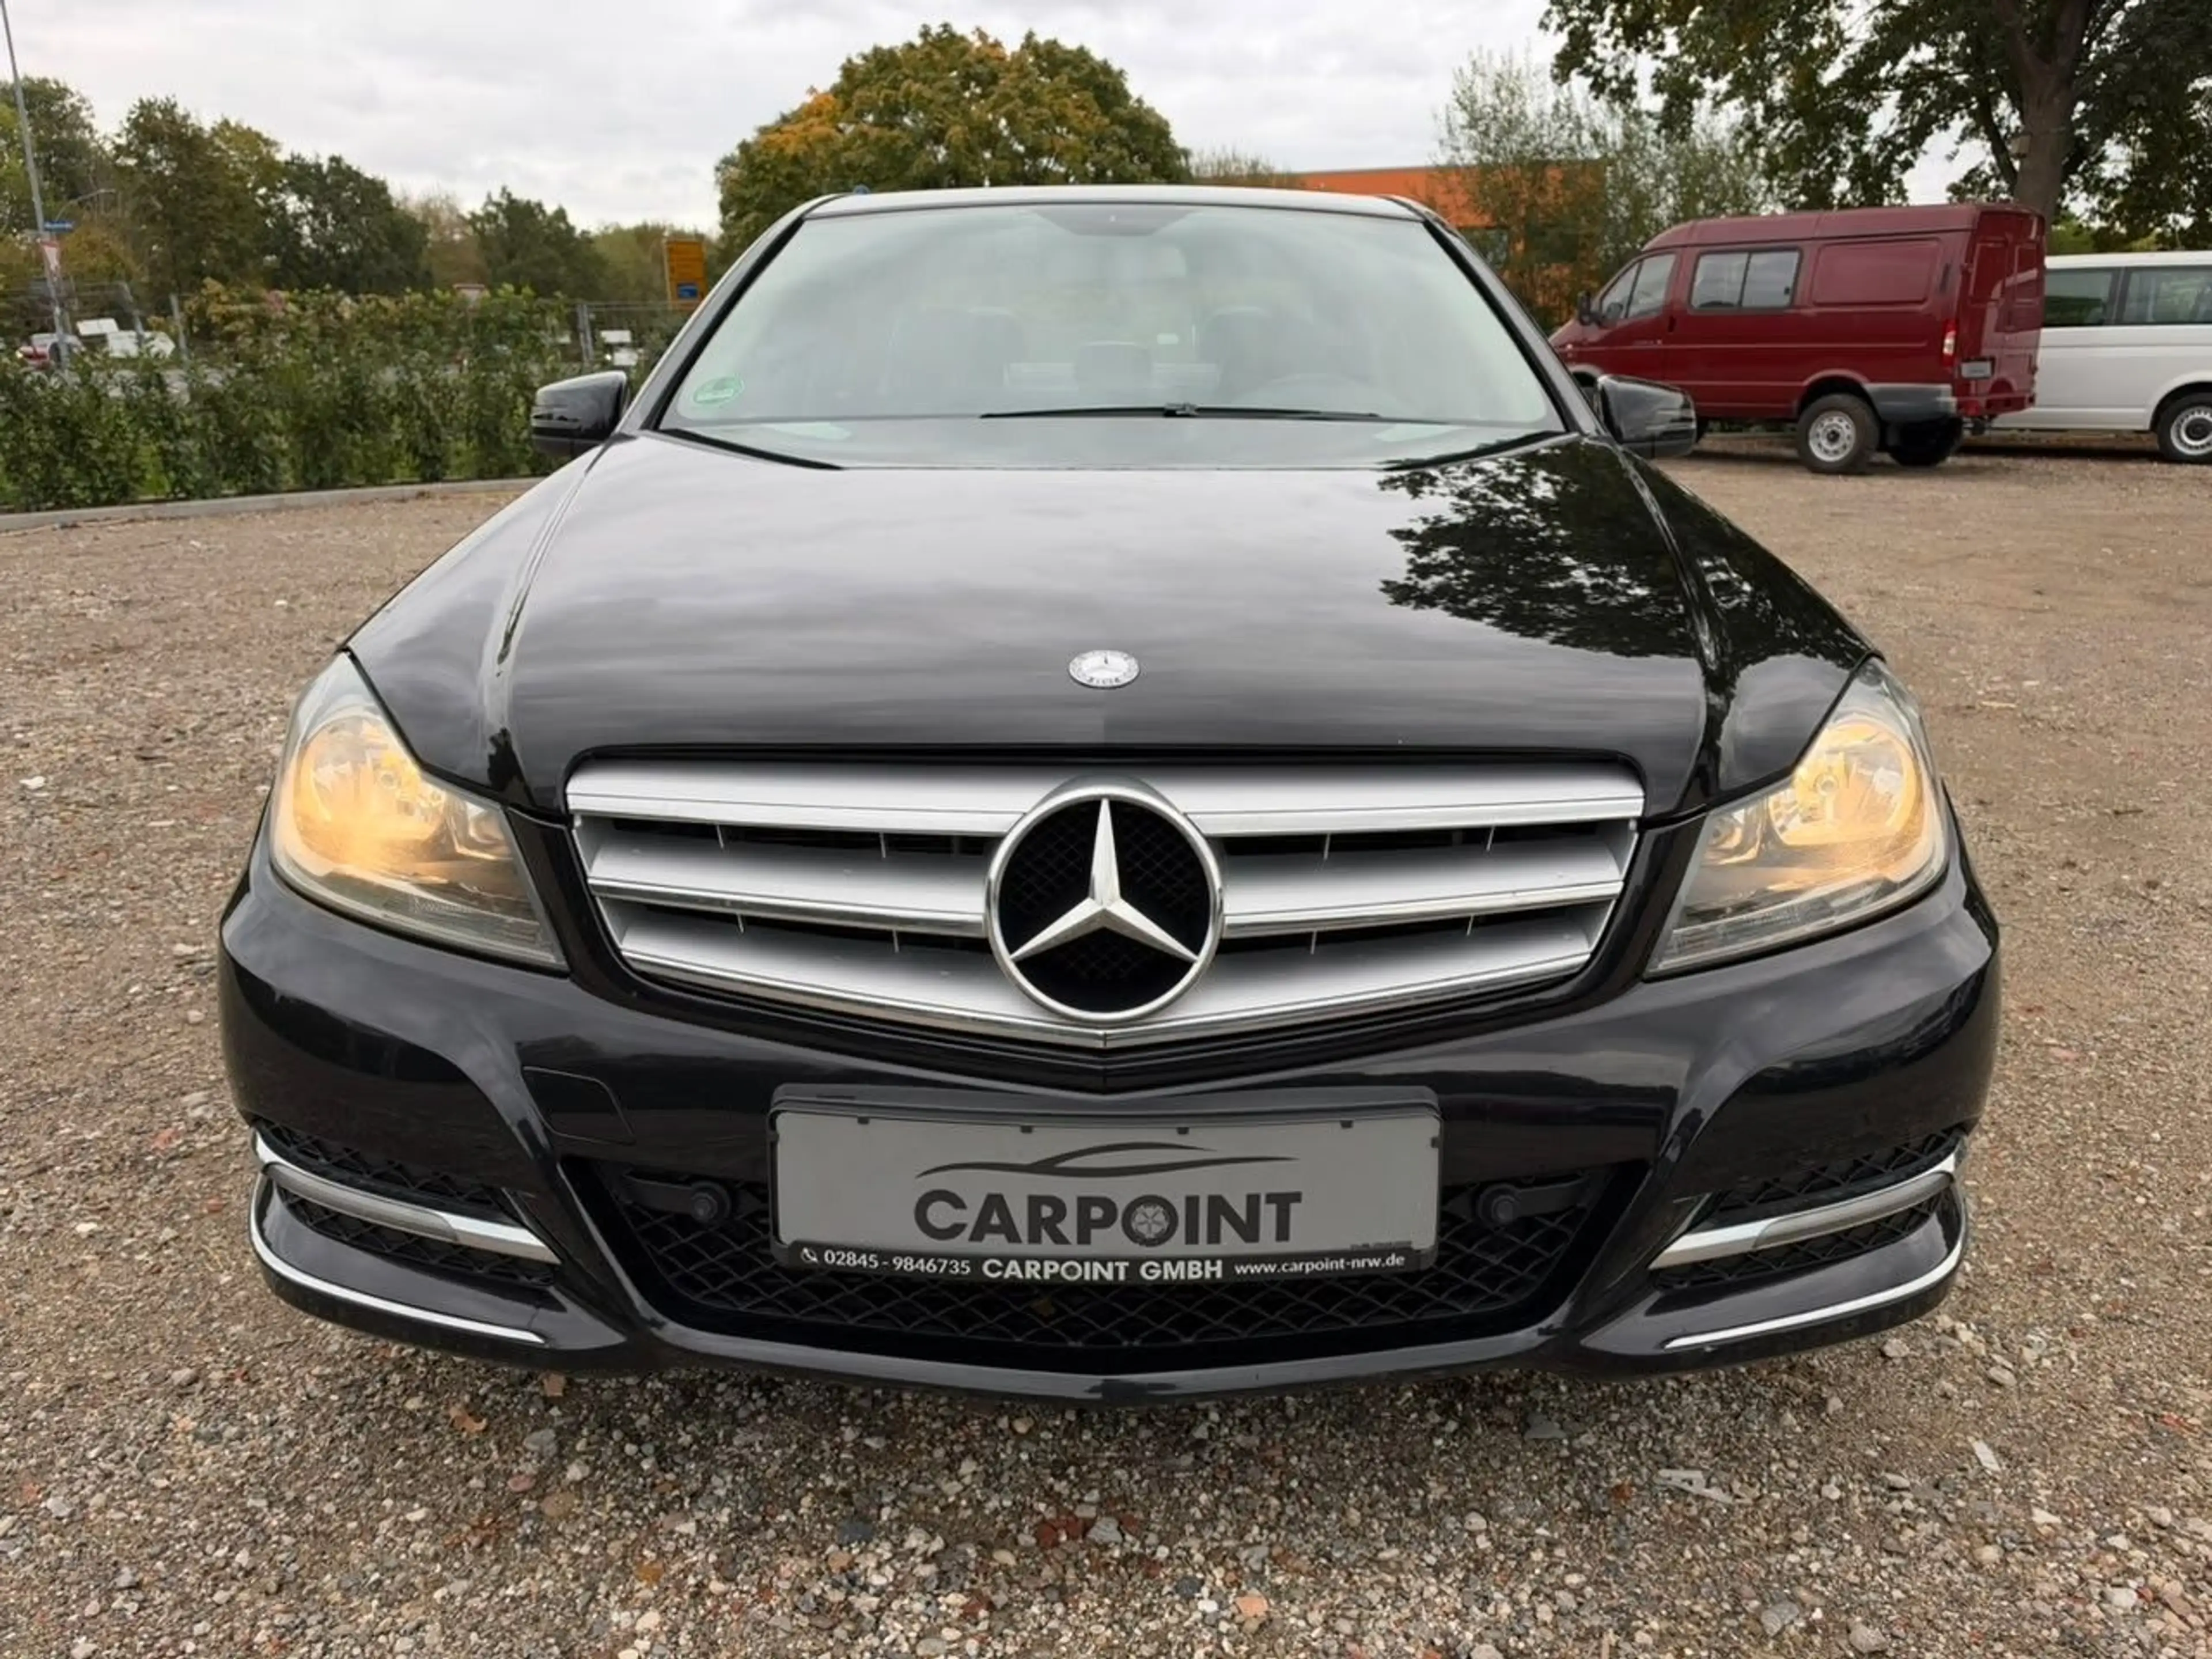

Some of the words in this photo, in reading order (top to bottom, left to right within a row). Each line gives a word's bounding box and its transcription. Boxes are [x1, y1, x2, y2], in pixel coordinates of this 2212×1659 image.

[914, 1189, 1302, 1247] CARPOINT
[982, 1259, 1128, 1281] CARPOINT
[1140, 1260, 1222, 1280] GMBH
[1234, 1252, 1405, 1274] www.carpoint-nrw.de
